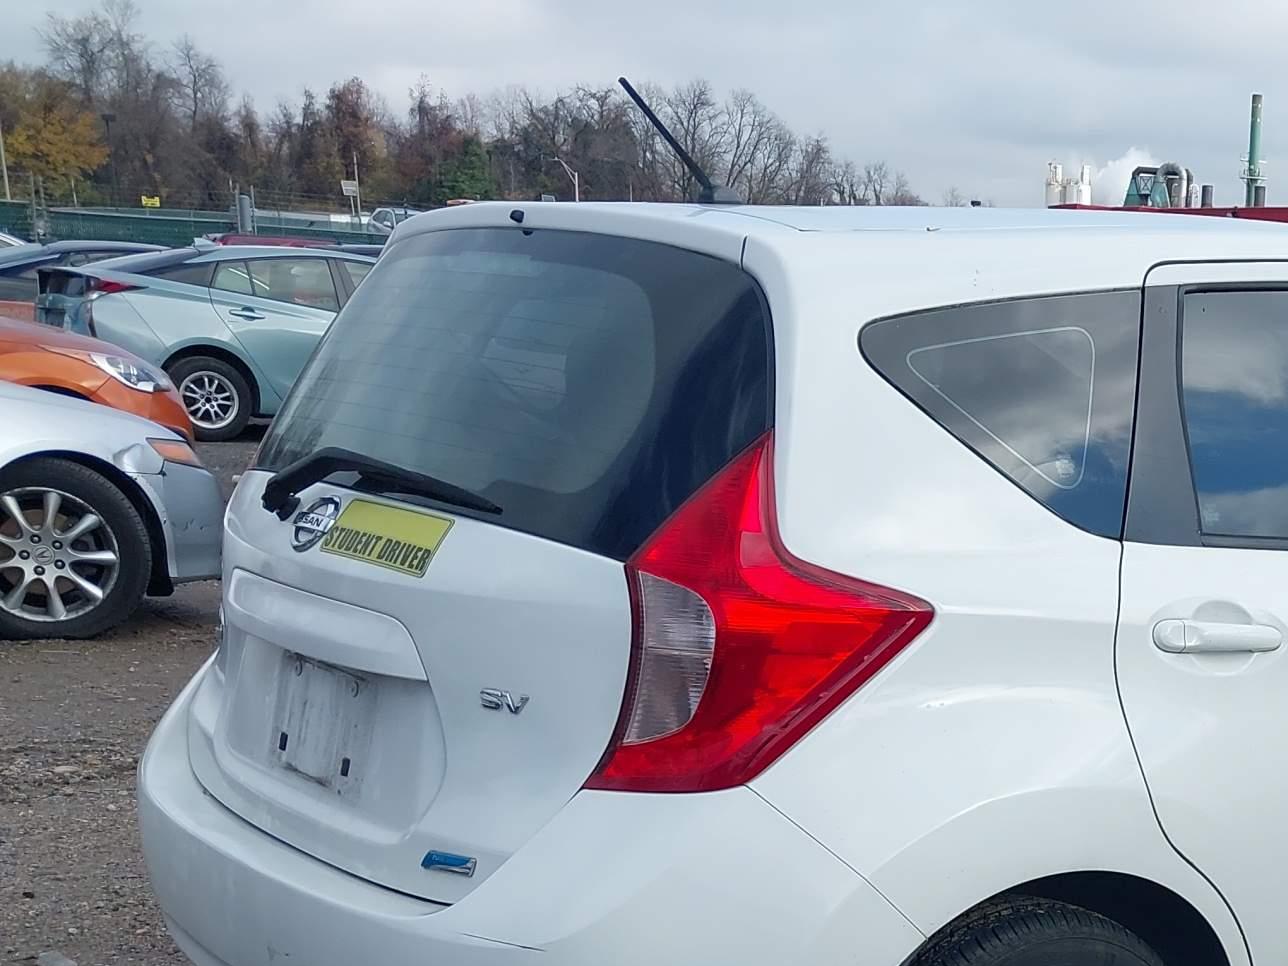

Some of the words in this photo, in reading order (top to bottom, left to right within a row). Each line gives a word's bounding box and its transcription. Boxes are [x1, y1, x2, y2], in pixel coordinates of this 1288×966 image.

[324, 525, 383, 557] STUDENT
[376, 538, 432, 572] DRIVER
[479, 688, 530, 715] SV
